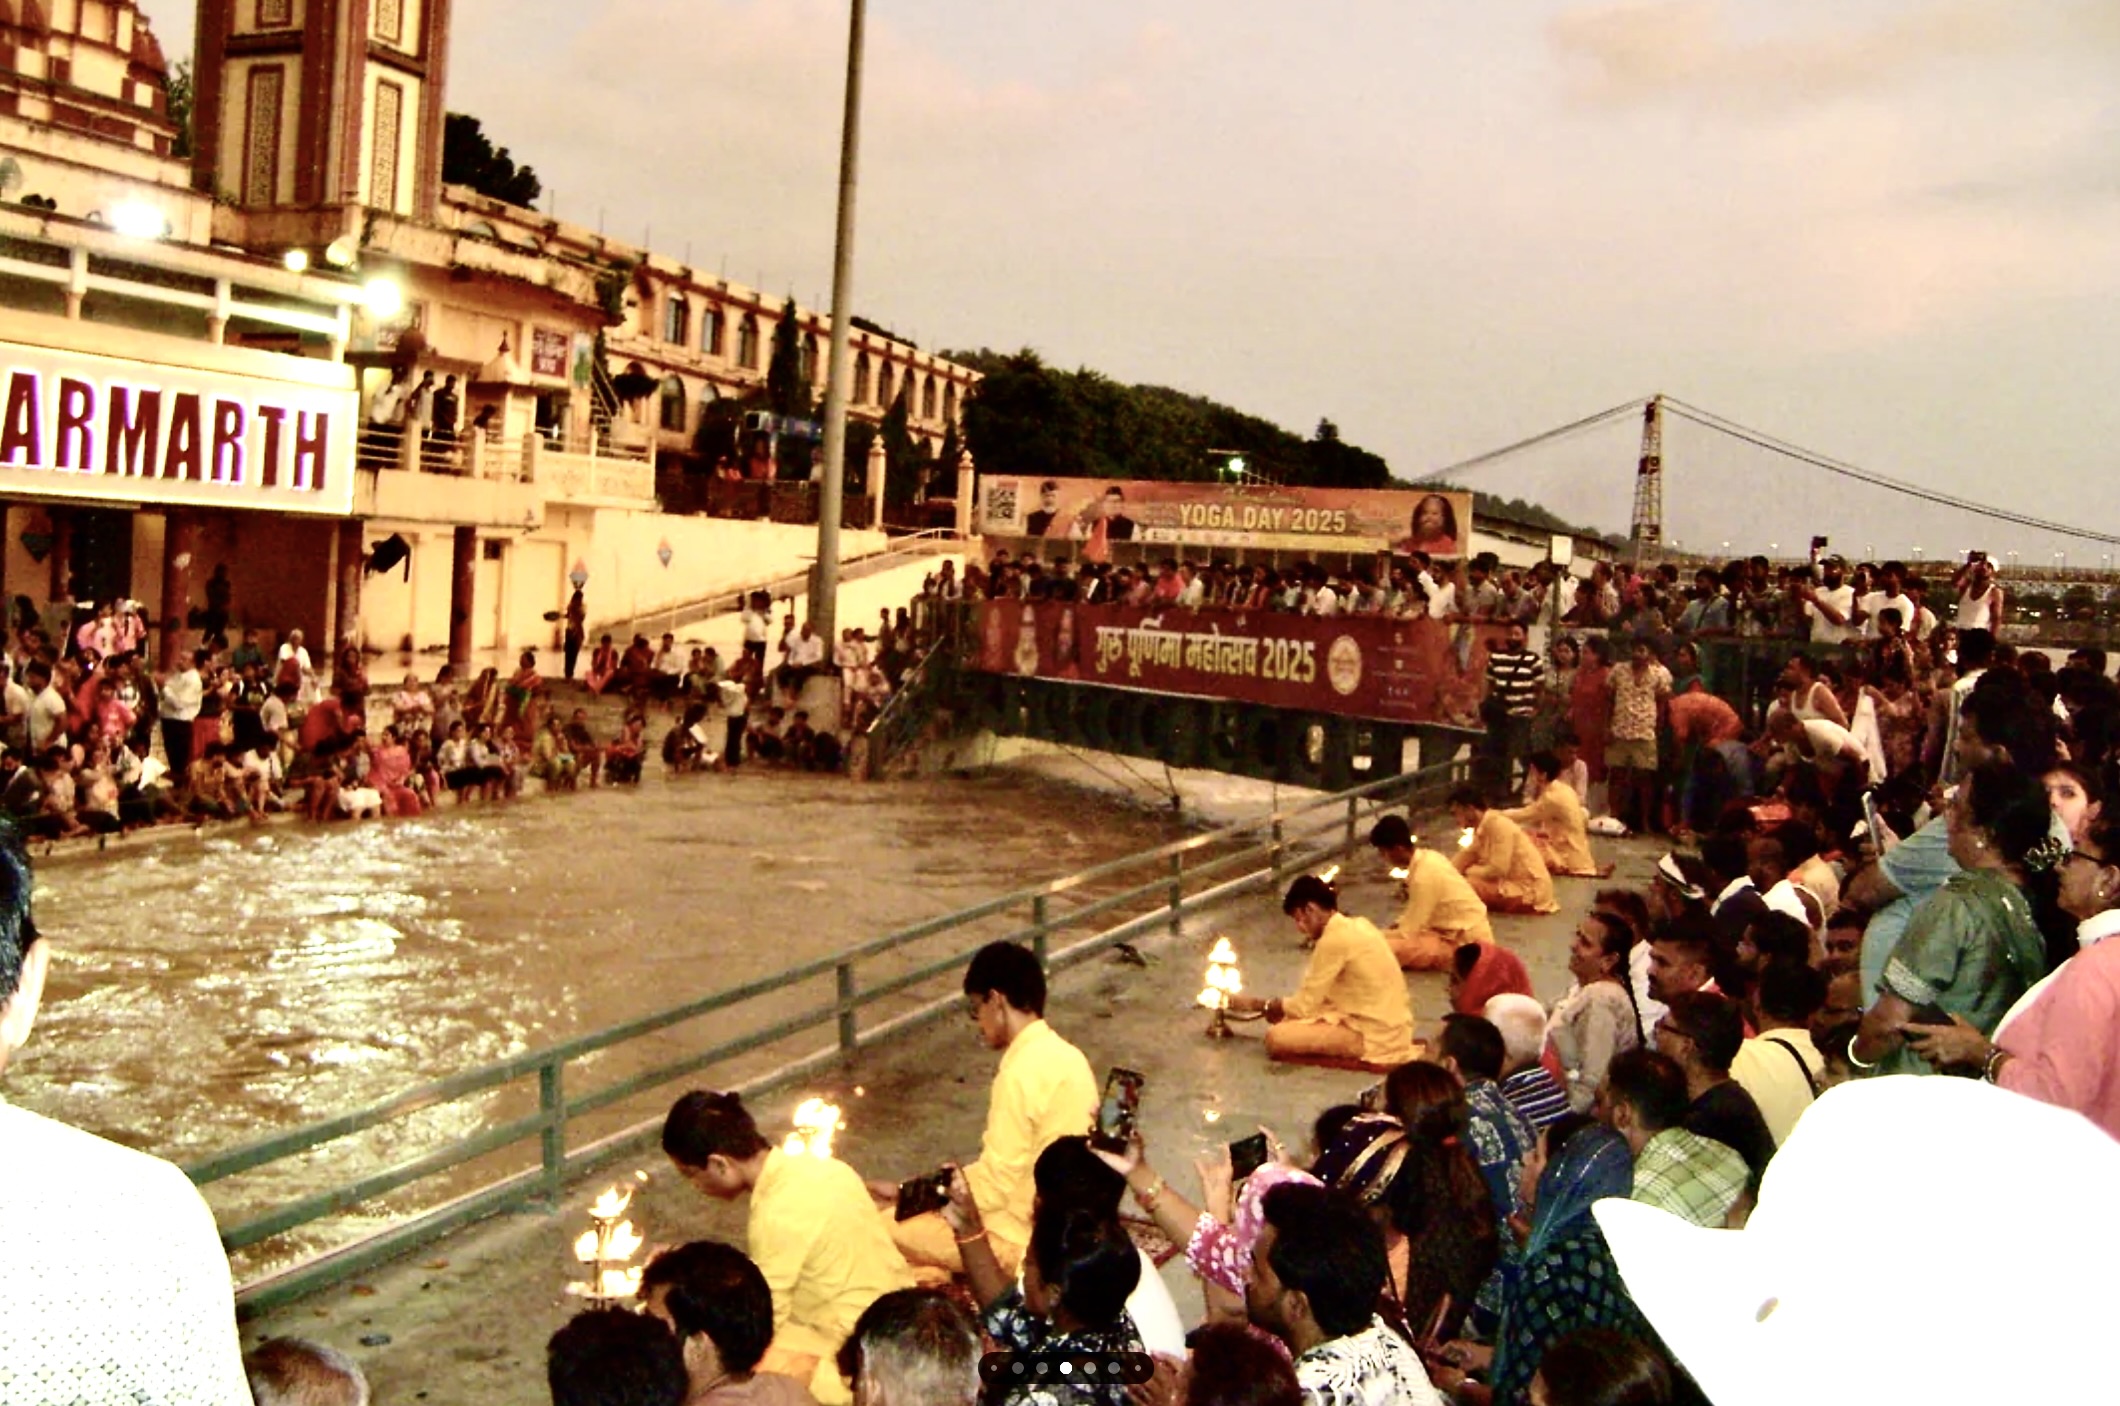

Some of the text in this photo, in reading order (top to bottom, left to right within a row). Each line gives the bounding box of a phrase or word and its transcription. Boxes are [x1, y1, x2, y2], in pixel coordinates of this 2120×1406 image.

[0, 371, 329, 491] ARMARTH
[1179, 503, 1235, 528] YOGA
[1243, 505, 1284, 530] DAY
[1291, 508, 1346, 533] 2025
[1095, 613, 1316, 683] गुरु पूर्णिमा महोत्सव 2025
